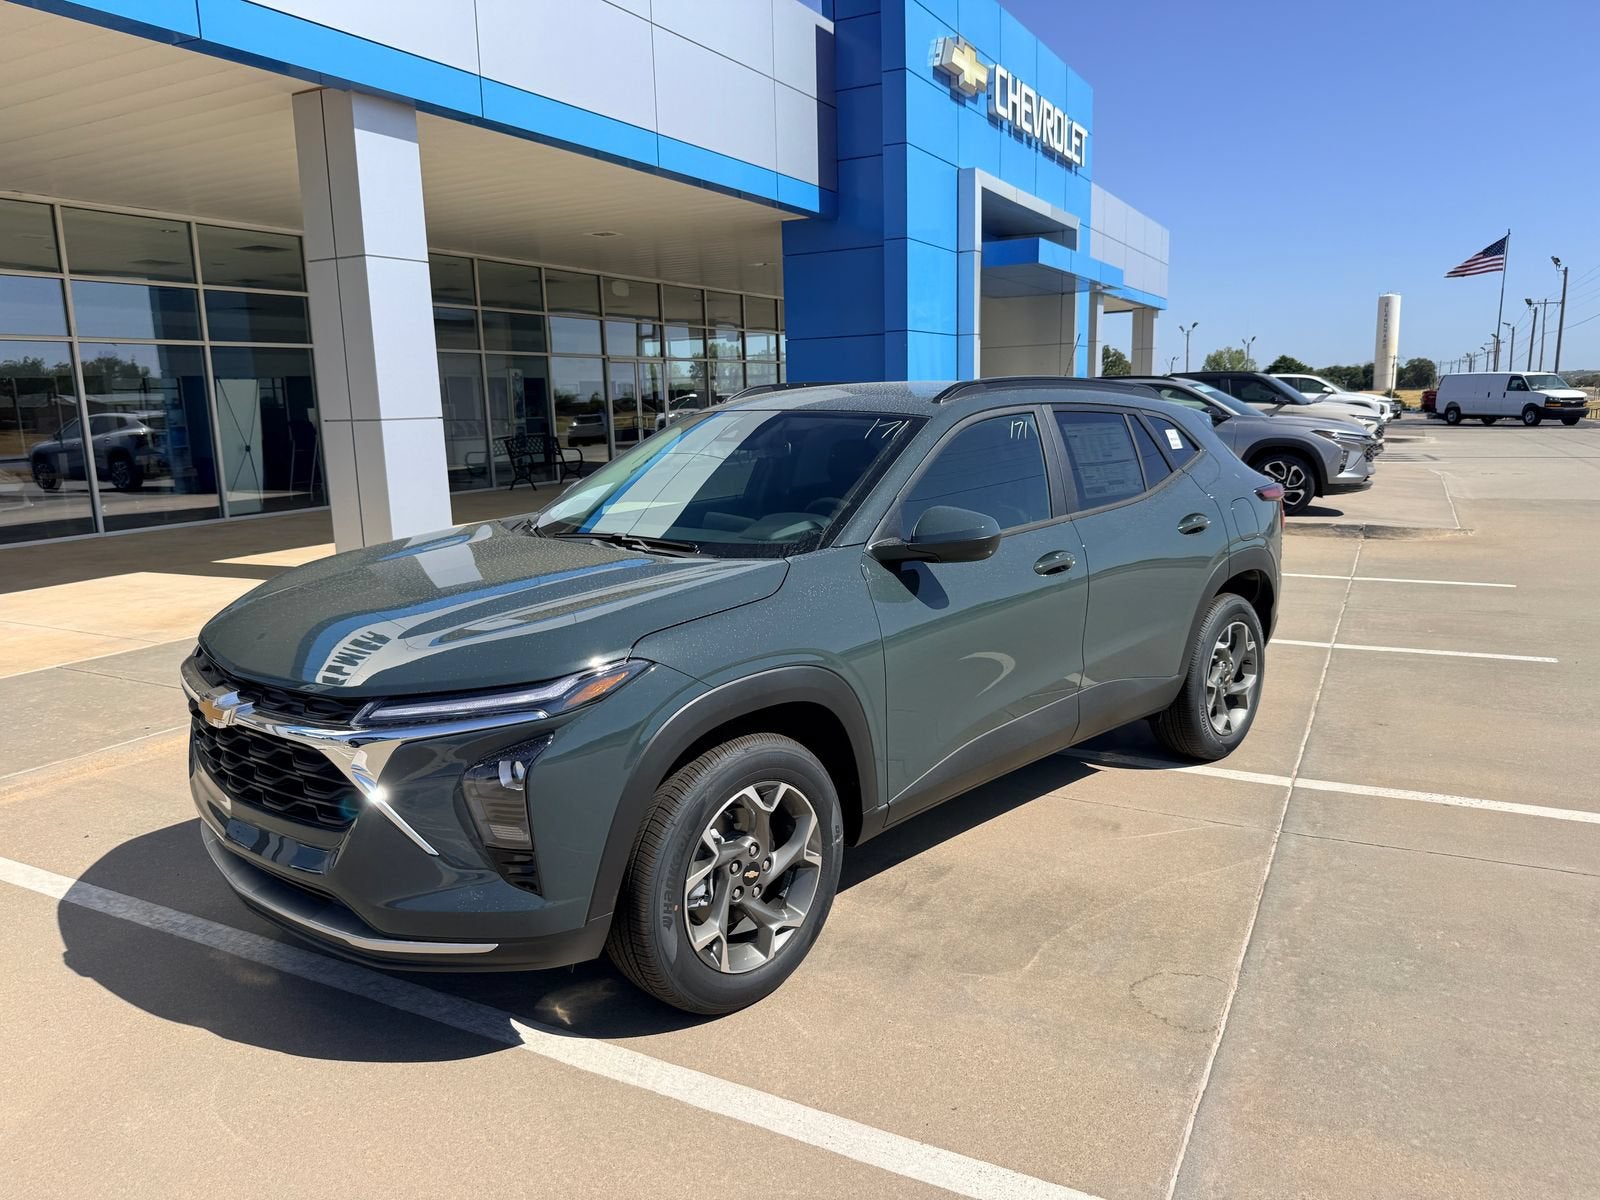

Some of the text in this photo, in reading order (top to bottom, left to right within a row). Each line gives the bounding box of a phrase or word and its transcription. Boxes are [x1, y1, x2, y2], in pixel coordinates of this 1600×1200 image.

[993, 63, 1088, 168] CHEVROLET
[864, 418, 910, 440] 171
[1010, 420, 1028, 440] 171
